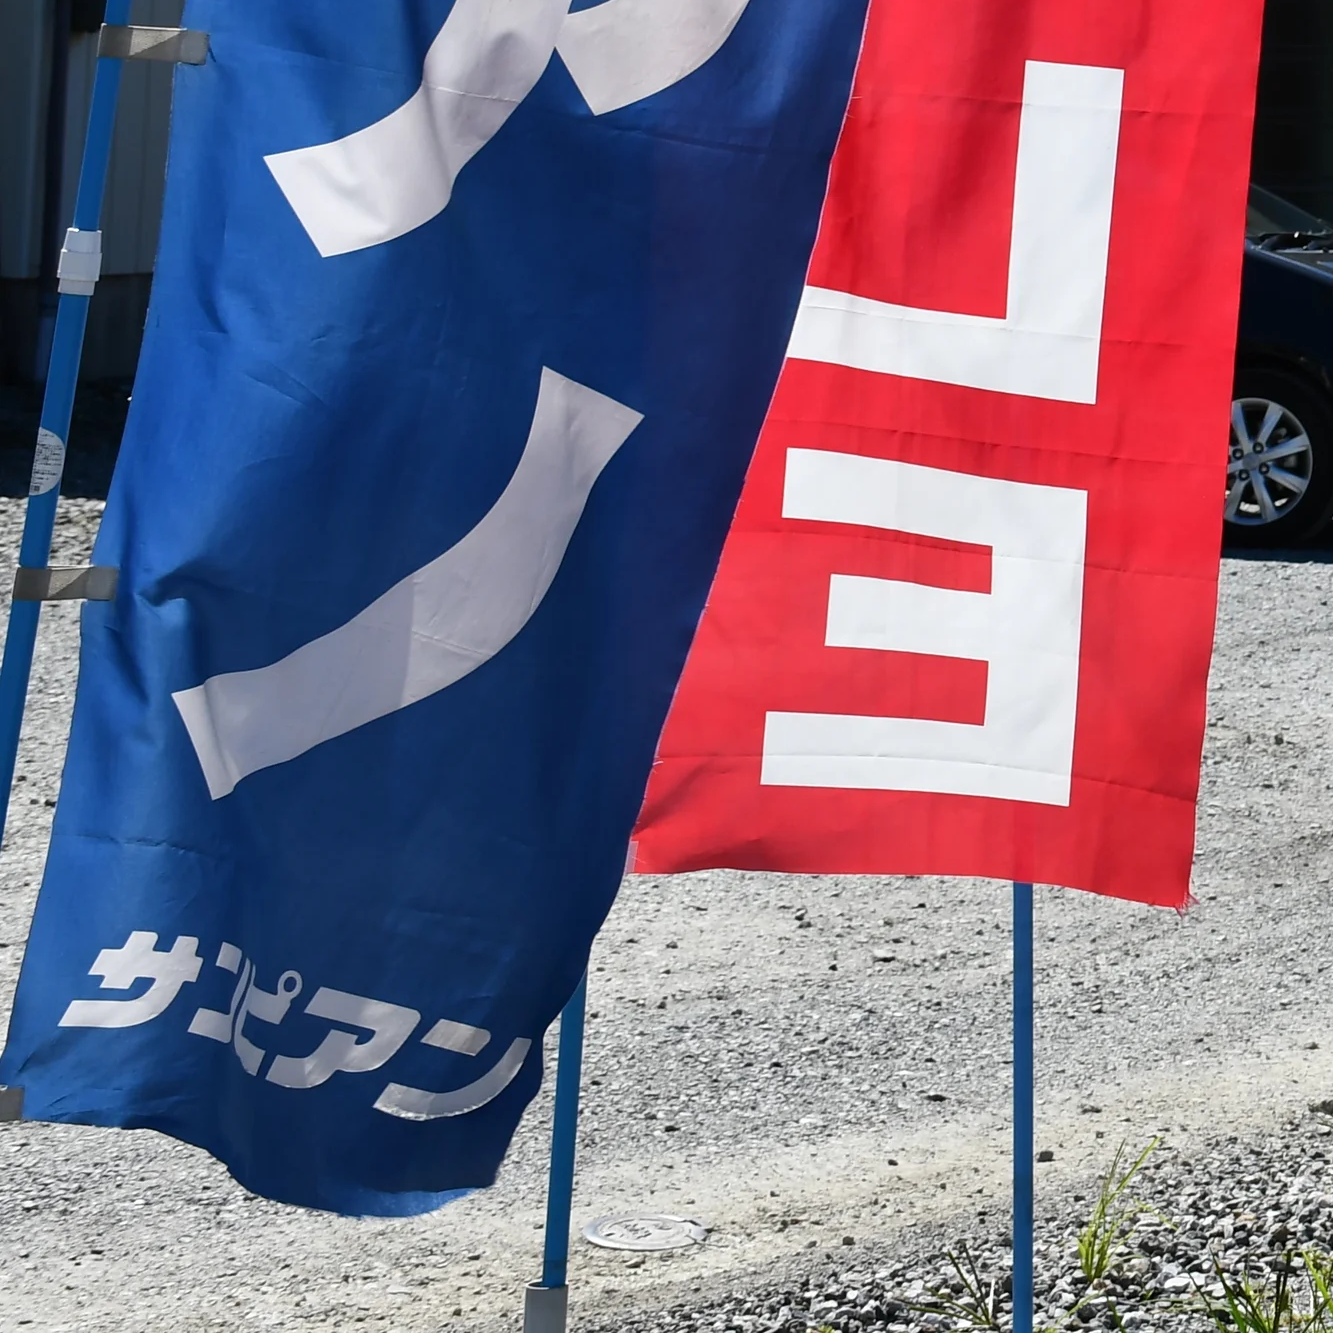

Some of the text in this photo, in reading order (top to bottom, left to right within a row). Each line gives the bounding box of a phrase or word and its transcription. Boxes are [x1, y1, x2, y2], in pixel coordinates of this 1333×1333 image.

[57, 929, 533, 1122] サンピアン
